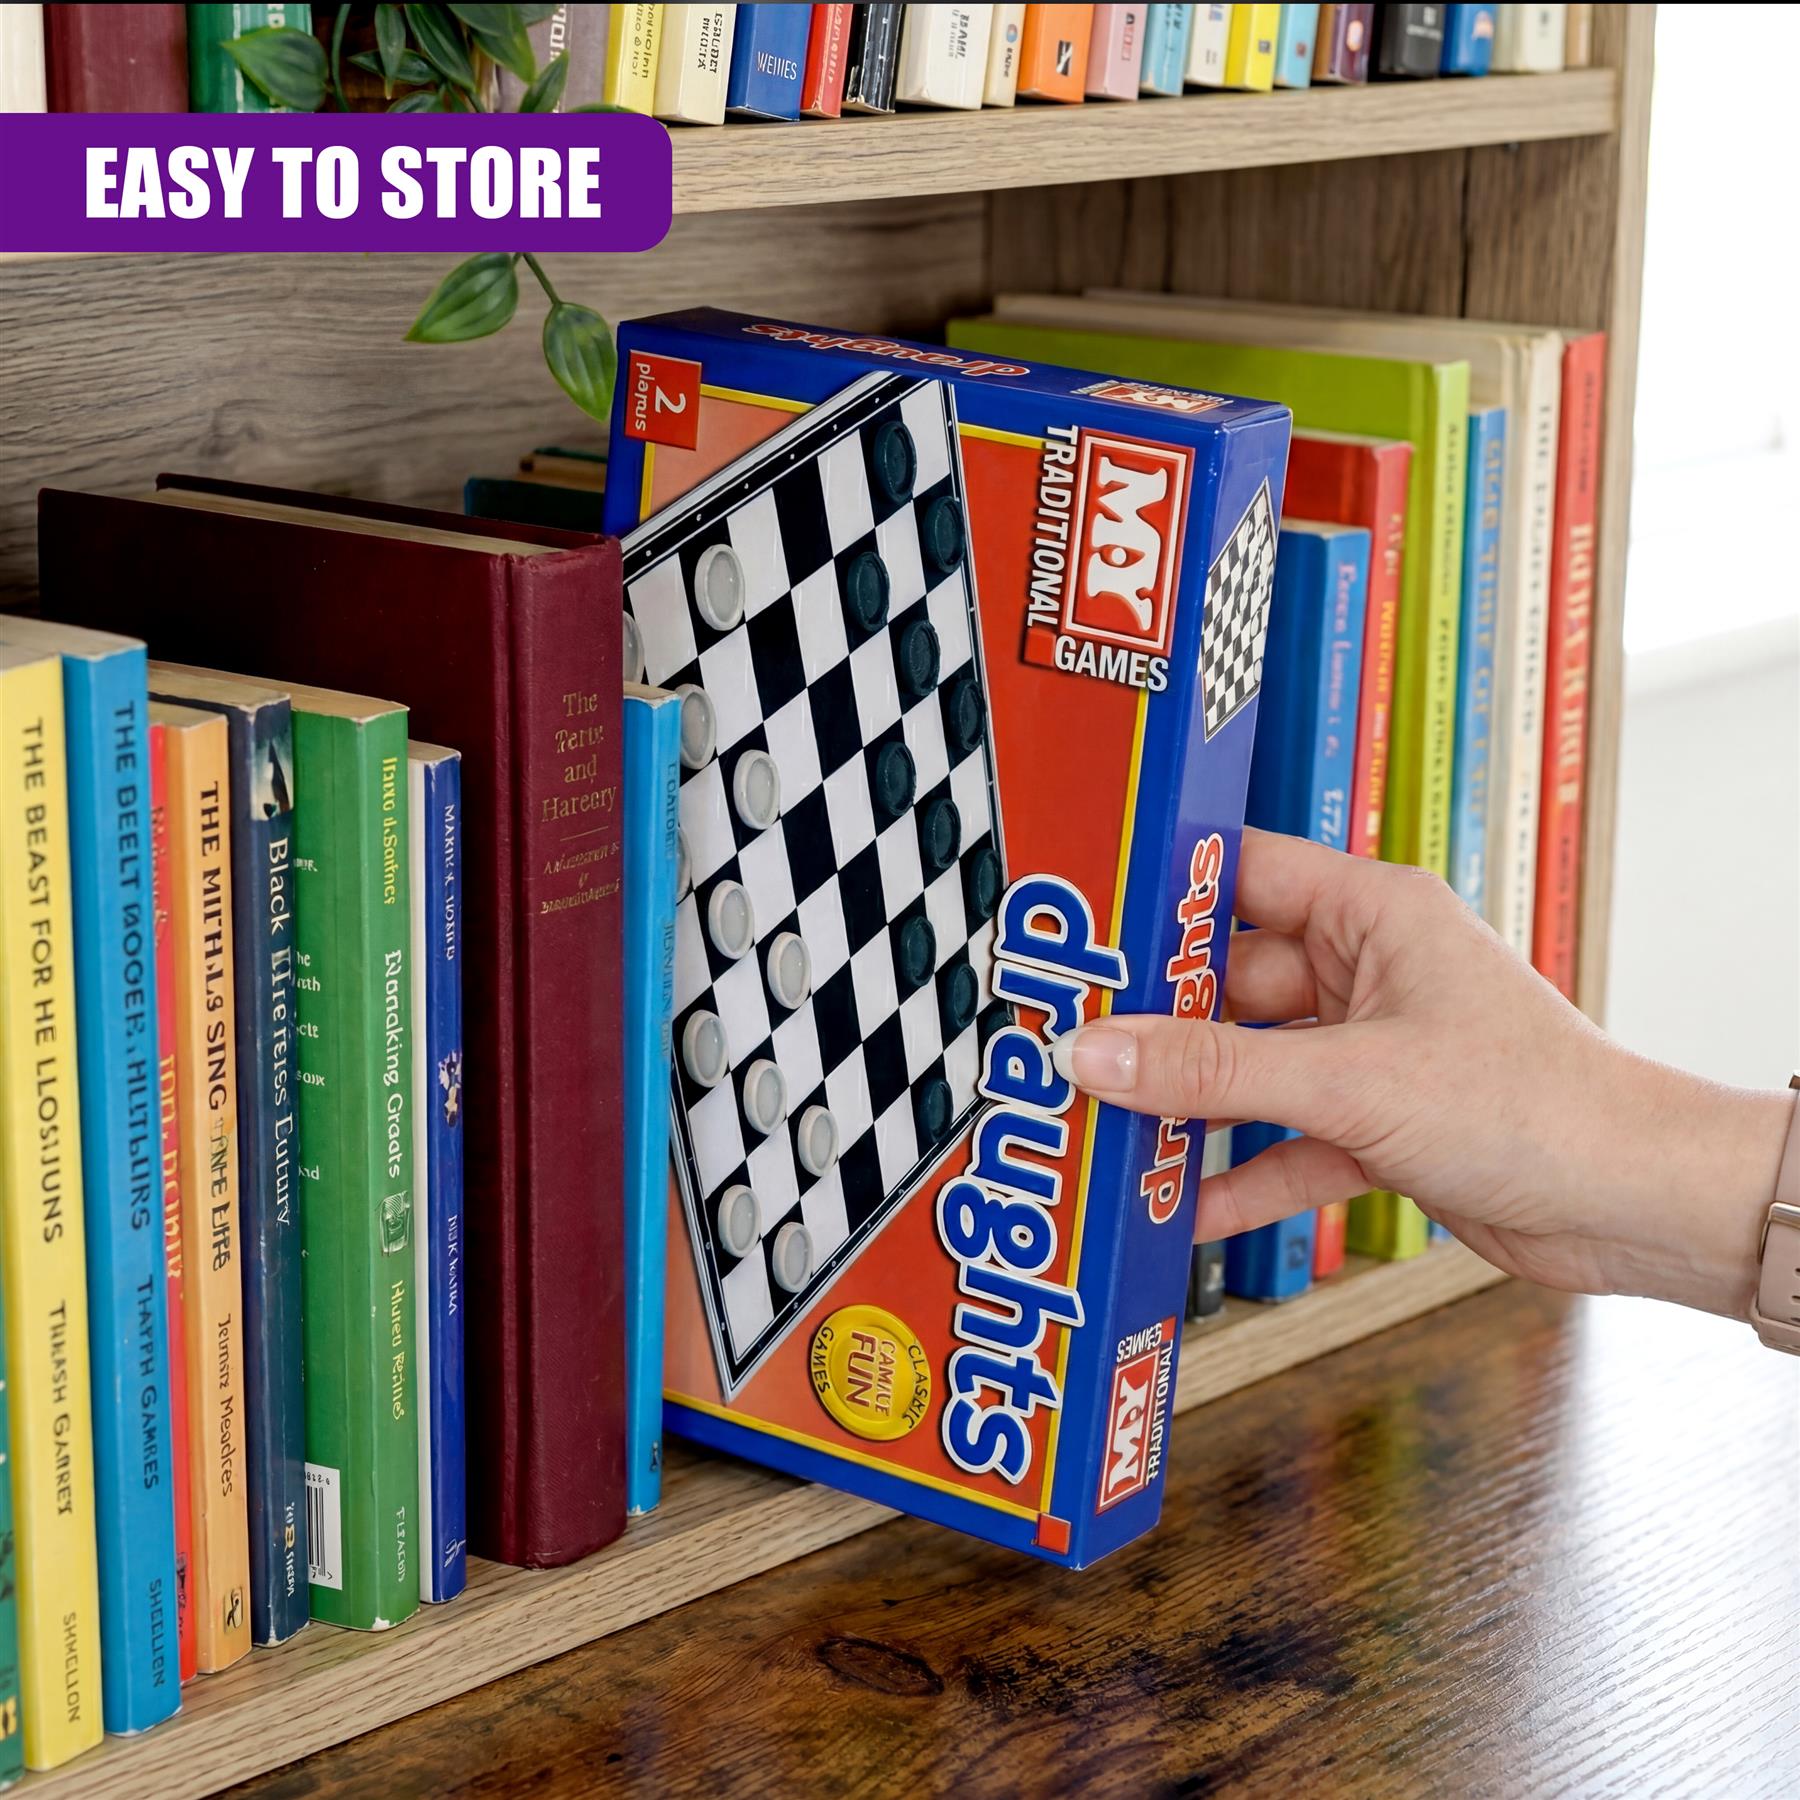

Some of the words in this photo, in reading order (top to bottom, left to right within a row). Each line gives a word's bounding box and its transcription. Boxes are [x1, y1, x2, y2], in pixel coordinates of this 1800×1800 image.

[742, 324, 1030, 376] draughts
[655, 385, 686, 414] 2
[1027, 425, 1079, 627] TRADITIONAL
[1086, 455, 1168, 632] MY
[1055, 635, 1168, 692] GAMES
[114, 700, 136, 773] THE
[562, 690, 598, 716] The
[23, 717, 44, 790] THE
[564, 754, 597, 783] and
[26, 804, 49, 907] BEAST
[201, 781, 221, 857] THE
[269, 837, 291, 936] Black
[30, 918, 53, 987] FOR
[34, 997, 56, 1046] HE
[1141, 832, 1224, 1225] drghts
[207, 1020, 227, 1111] SING
[936, 873, 1128, 1485] draughts
[813, 1326, 834, 1394] GAMES
[846, 1331, 877, 1408] FUN
